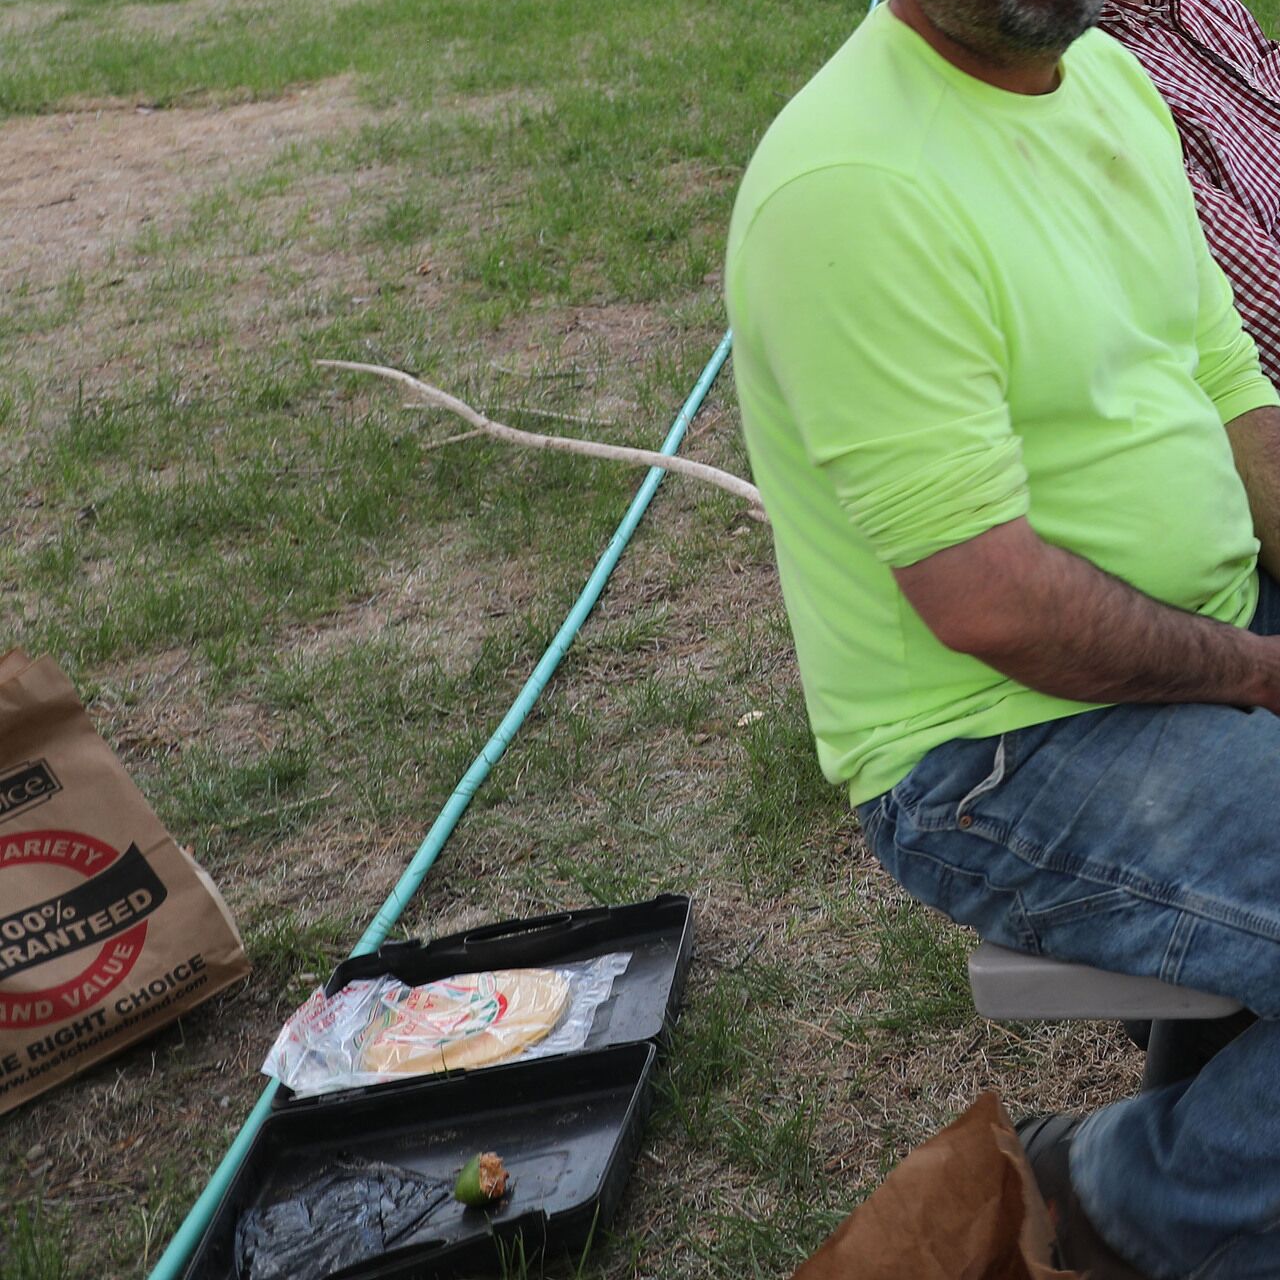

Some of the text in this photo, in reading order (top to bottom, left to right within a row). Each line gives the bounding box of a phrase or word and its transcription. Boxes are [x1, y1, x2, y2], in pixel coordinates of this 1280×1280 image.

[0, 775, 46, 812] ice
[0, 837, 104, 867] ARIETY
[0, 899, 77, 946] 00%
[62, 942, 134, 1008] VALUE
[0, 952, 207, 1077] E RIGHT CHOICE
[0, 973, 208, 1096] ww.bestchoicebrand.com
